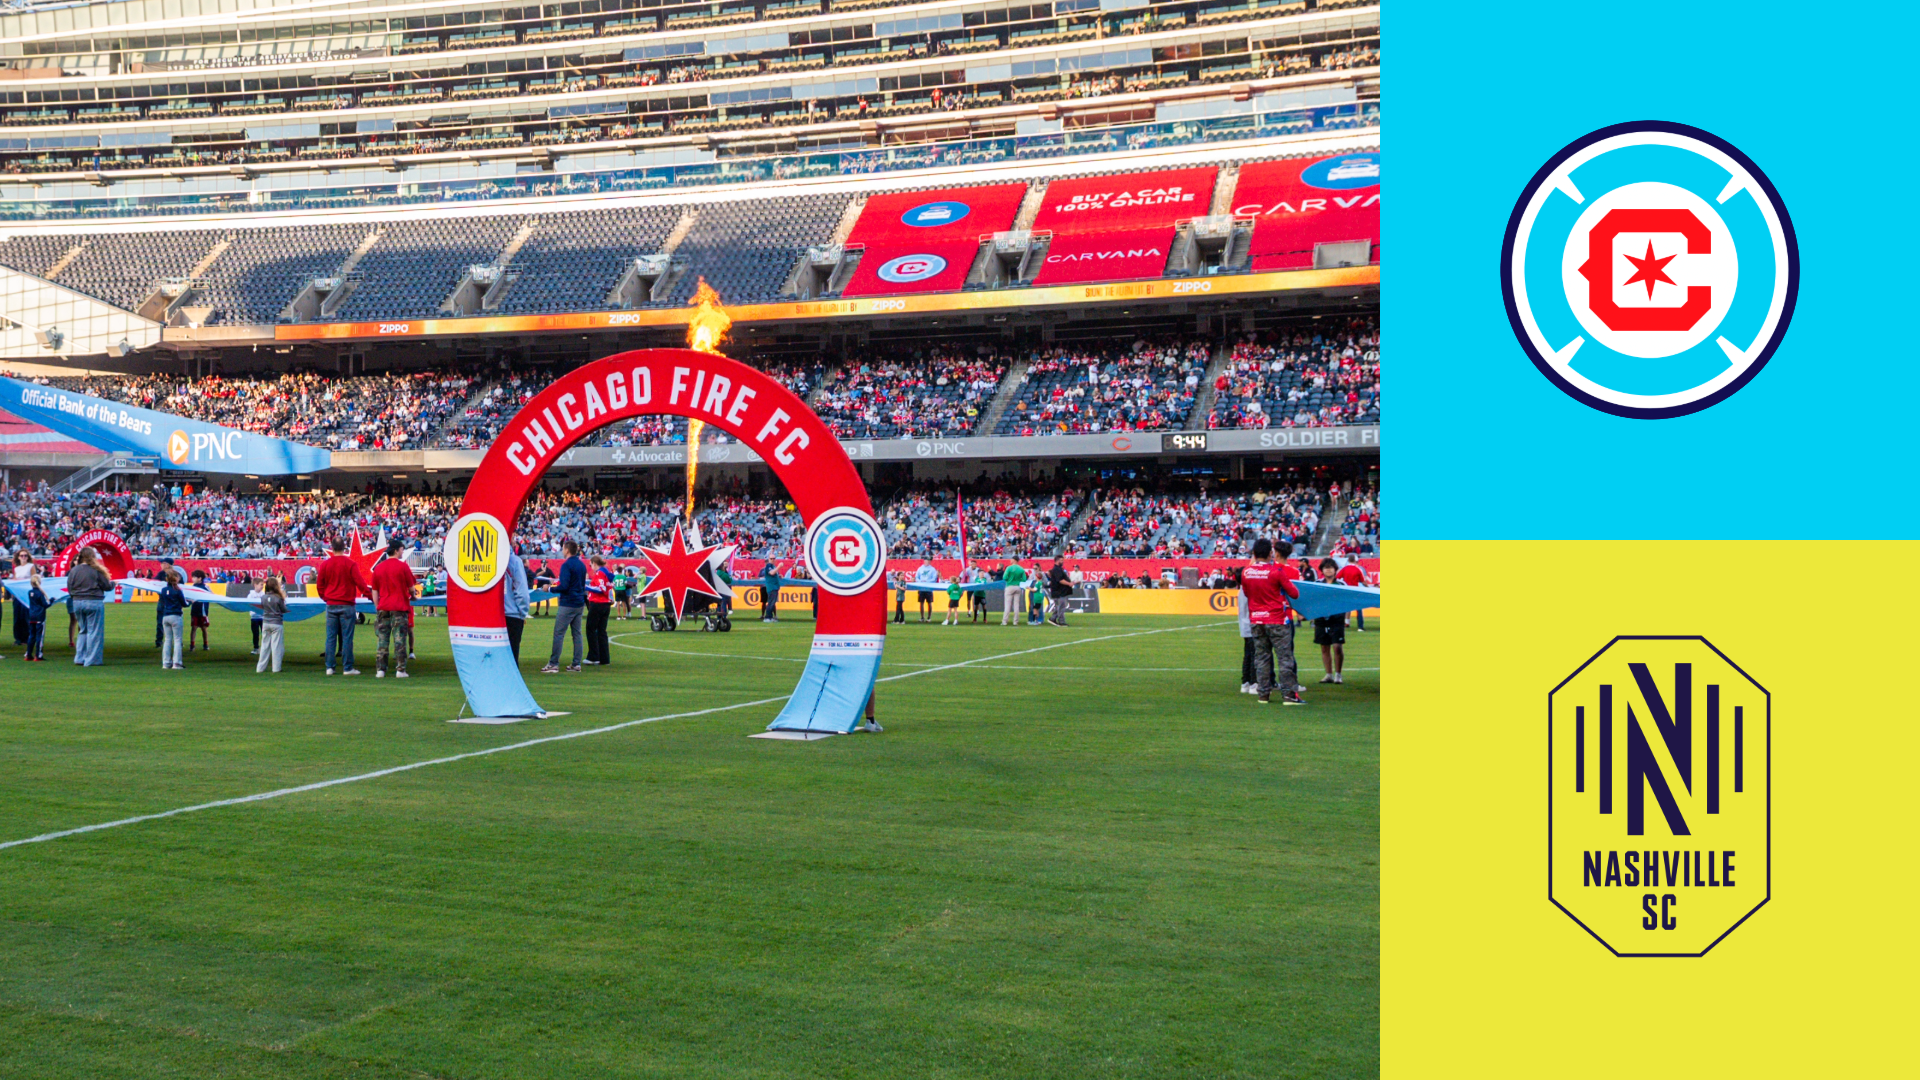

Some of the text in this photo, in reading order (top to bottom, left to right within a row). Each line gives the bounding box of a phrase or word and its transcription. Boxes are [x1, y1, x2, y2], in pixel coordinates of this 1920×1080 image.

[212, 56, 251, 64] SECURITY
[259, 52, 309, 61] ASSISTANCE
[307, 53, 358, 63] LOCATION
[1071, 186, 1183, 204] BUY A CAR
[1055, 192, 1196, 213] 100% ONLINE
[1047, 248, 1161, 263] CARVANA
[1173, 281, 1211, 293] ZIPPO
[871, 299, 905, 311] ZIPPO
[608, 313, 640, 324] ZIPPO
[379, 323, 409, 334] ZIPPO
[21, 388, 152, 435] Official Bank of the Bears
[506, 366, 810, 476] CHICAGO FIRE FC
[1172, 434, 1206, 450] 9:44
[1260, 430, 1349, 448] SOLDIER
[192, 431, 243, 461] PNC
[933, 442, 965, 455] PNC
[628, 450, 683, 462] Advocate
[75, 531, 127, 553] CHICAGO FIRE FC
[463, 564, 491, 573] NASHVILLE
[473, 573, 481, 582] SC
